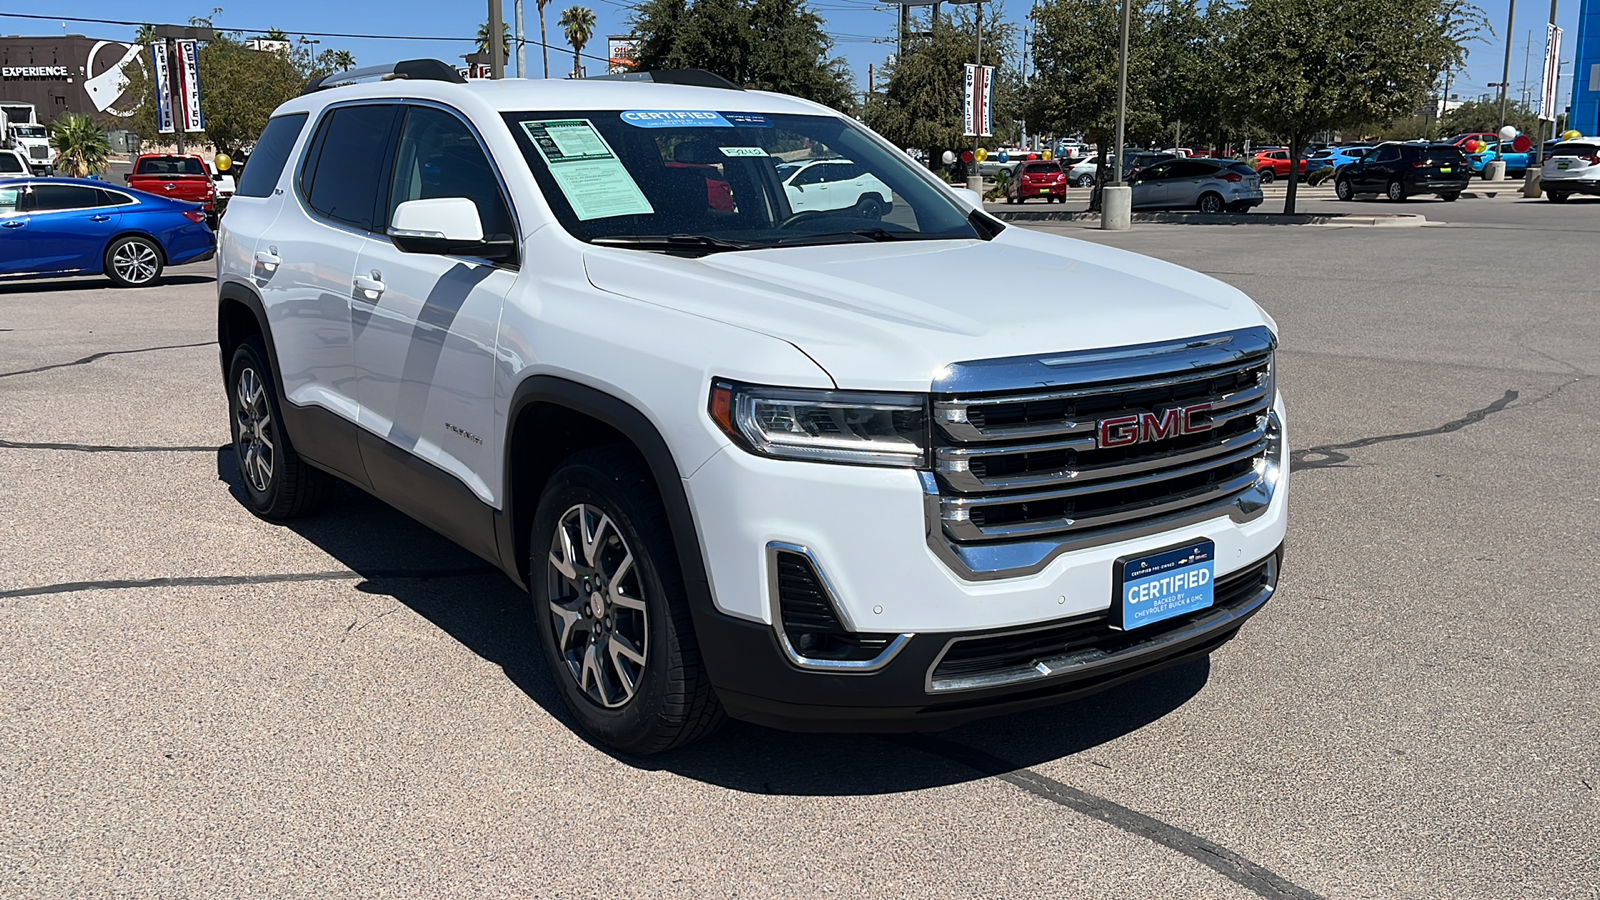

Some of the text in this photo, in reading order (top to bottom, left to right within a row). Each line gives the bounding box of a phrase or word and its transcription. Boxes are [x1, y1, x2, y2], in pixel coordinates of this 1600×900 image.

[2, 66, 68, 76] EXPERIENCE
[158, 45, 171, 127] CERTIFIED
[183, 43, 199, 127] CERTIFIED
[624, 111, 718, 120] CERTIFIED
[1098, 402, 1214, 448] GMC
[1128, 568, 1210, 605] CERTIFIED
[1153, 595, 1177, 607] BACKED
[1134, 603, 1168, 619] CHEVROLET
[1168, 601, 1185, 609] BUICK
[1191, 593, 1203, 603] GMC
